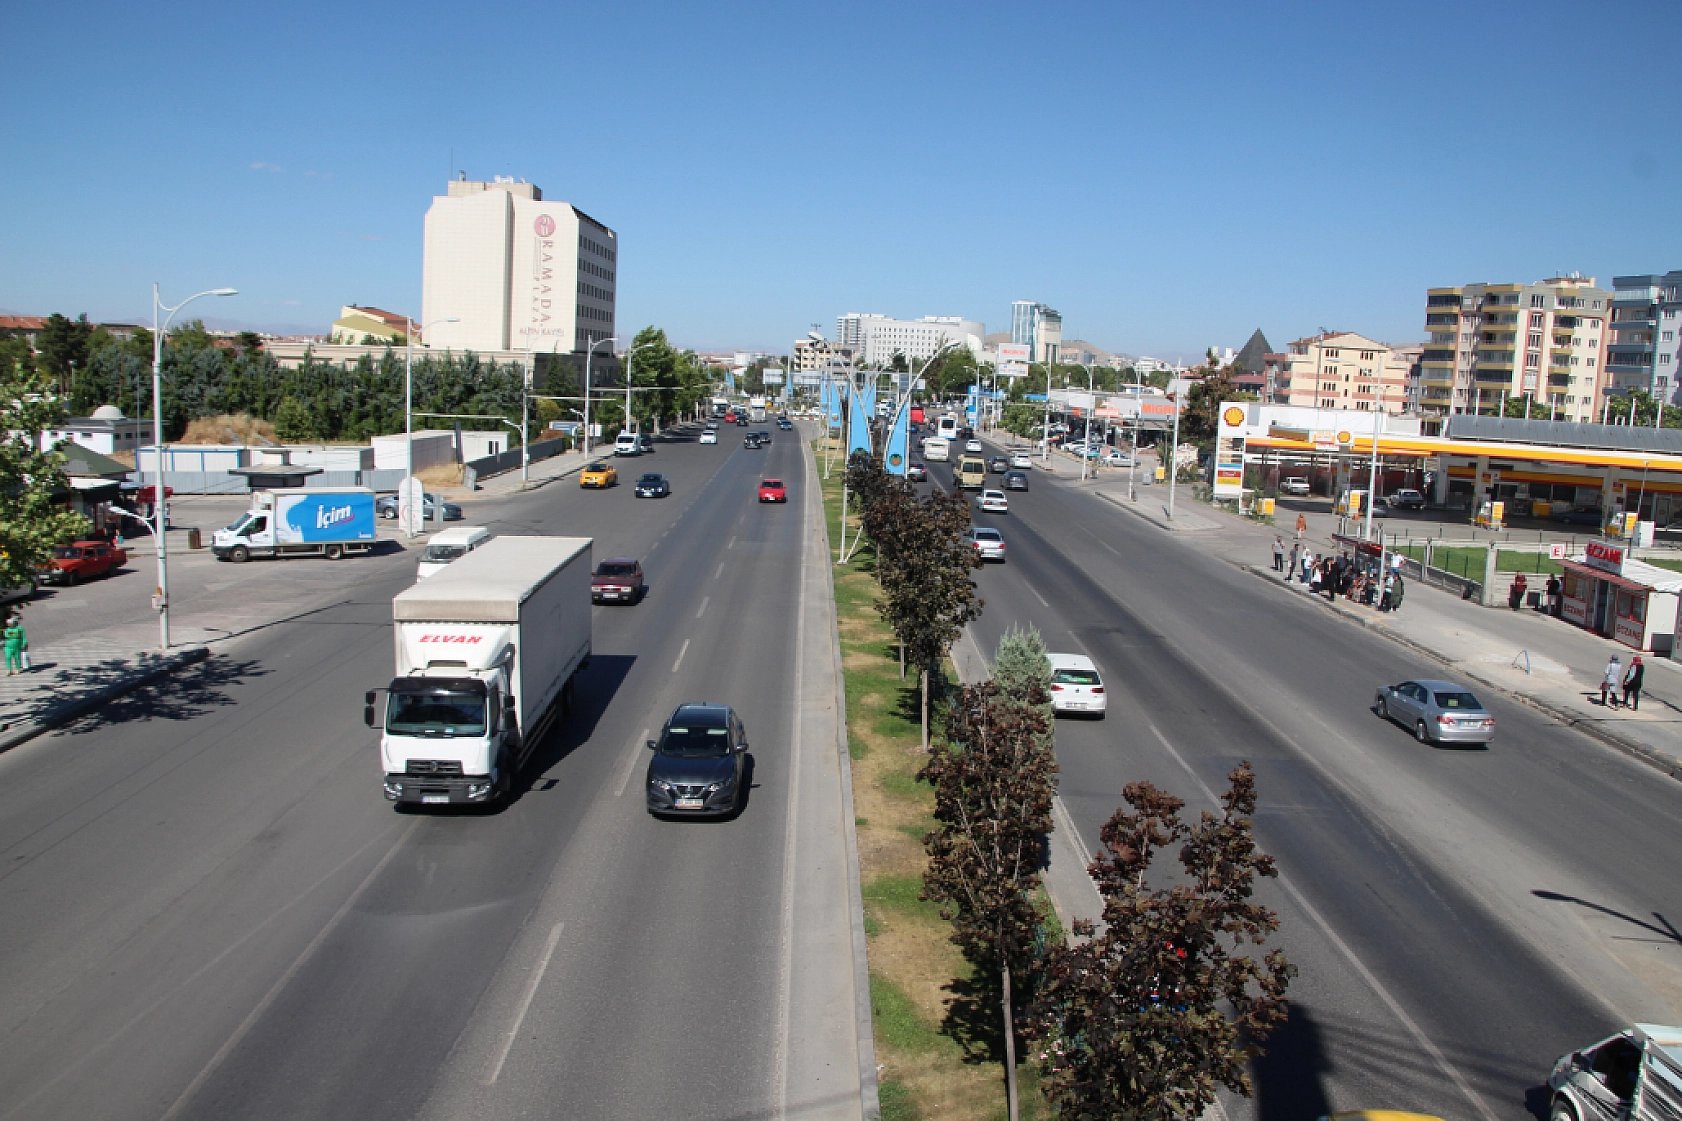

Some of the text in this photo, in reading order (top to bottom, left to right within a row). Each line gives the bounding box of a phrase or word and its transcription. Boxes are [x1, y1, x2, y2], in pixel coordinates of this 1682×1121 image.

[541, 240, 554, 323] RAMADA
[532, 276, 541, 323] PLAZA
[316, 504, 351, 529] İçim
[1587, 542, 1623, 565] ECZANE
[418, 634, 483, 645] ELVAN
[1617, 623, 1641, 641] ECZANE
